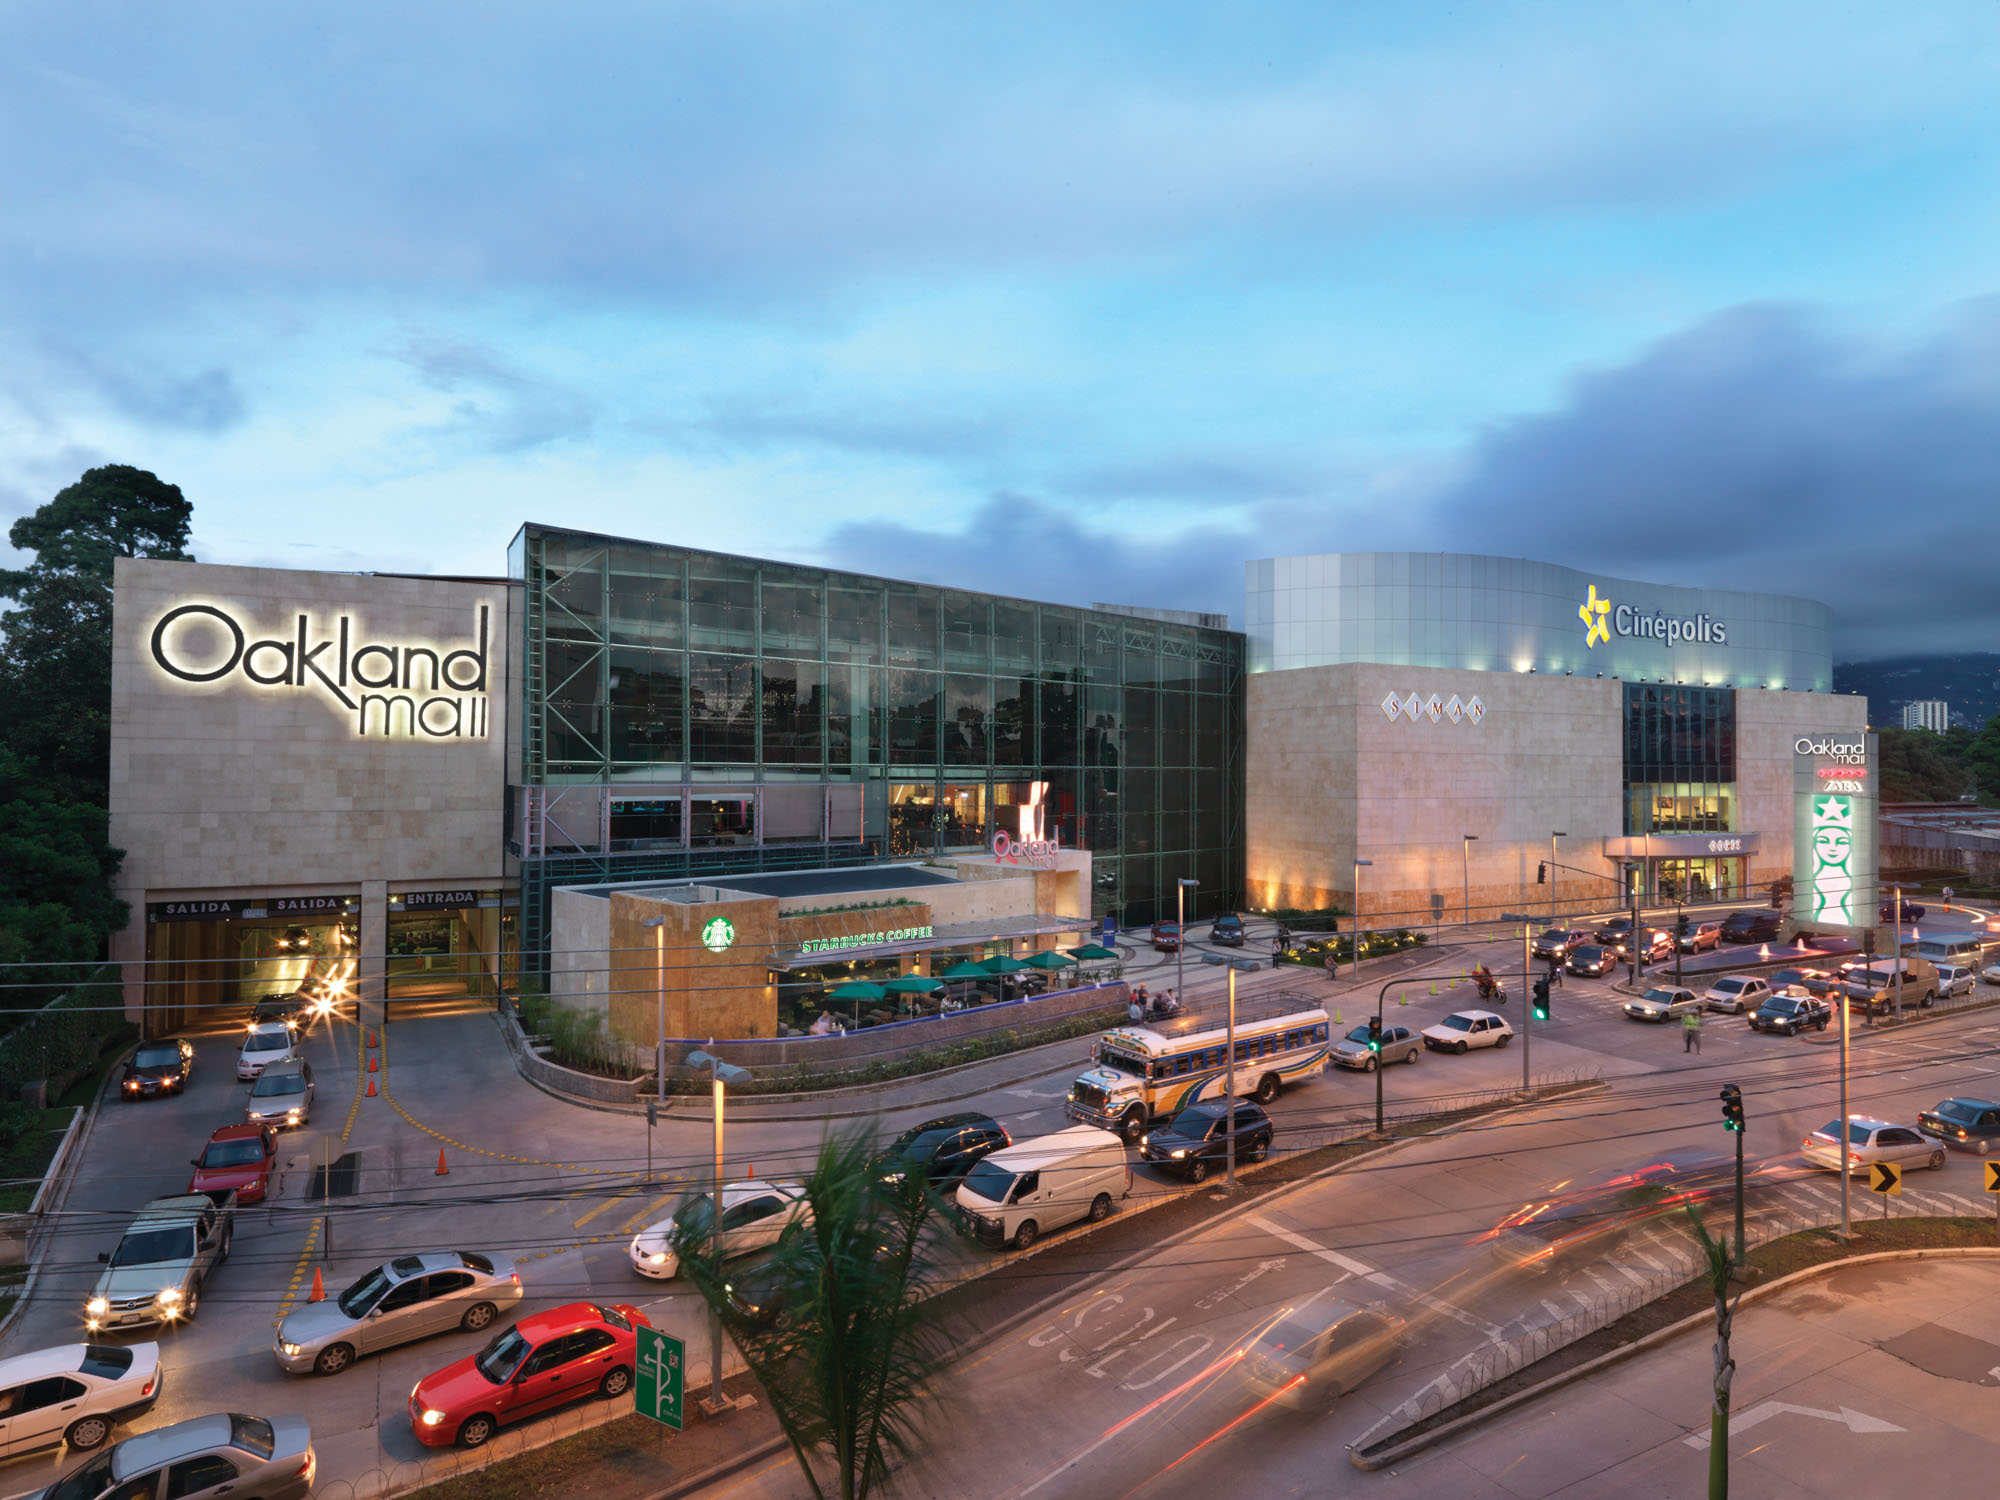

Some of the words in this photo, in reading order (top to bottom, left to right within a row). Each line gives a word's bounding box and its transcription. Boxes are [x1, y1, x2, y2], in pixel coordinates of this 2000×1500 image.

[1615, 603, 1727, 647] Cinépolis
[151, 605, 488, 710] Oakland
[360, 694, 487, 738] mall
[1794, 733, 1865, 759] Oakland
[1836, 754, 1865, 765] mall
[1823, 780, 1864, 792] ZARA
[993, 825, 1059, 862] Oakland
[166, 901, 231, 914] SALIDA
[277, 898, 337, 911] SALIDA
[406, 891, 475, 905] ENTRADA
[802, 931, 884, 953] STARBUCKS
[886, 926, 933, 942] COFFEE
